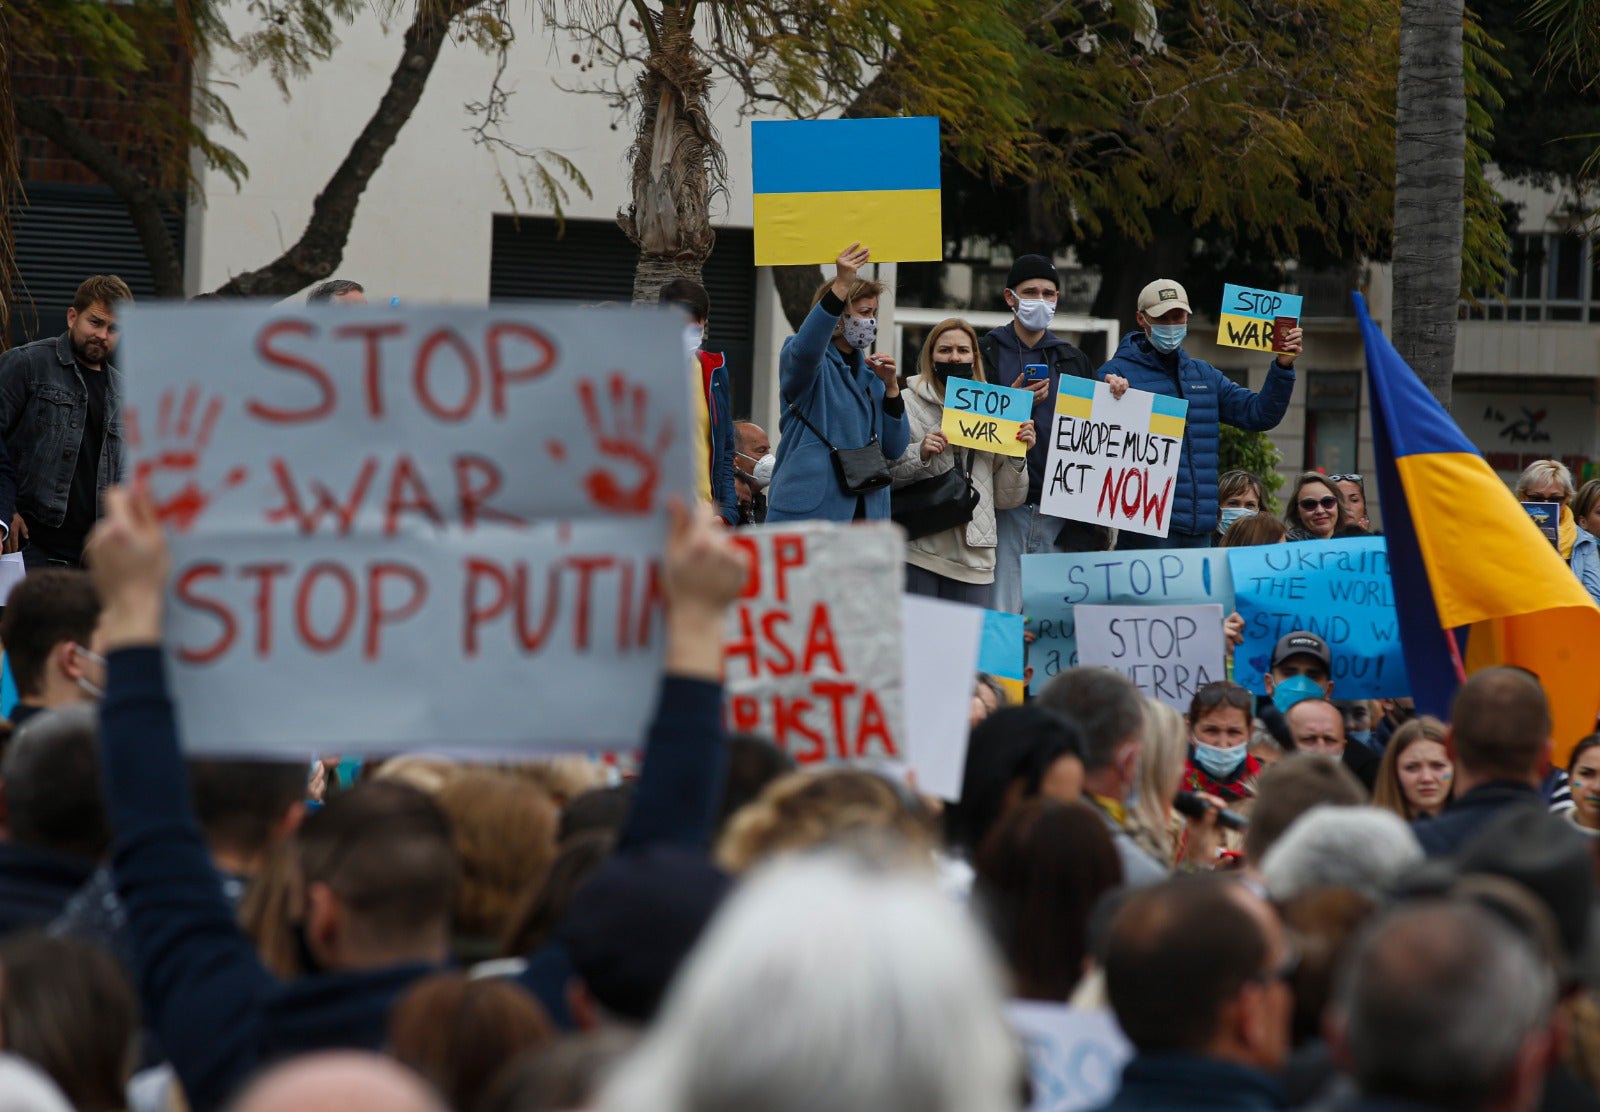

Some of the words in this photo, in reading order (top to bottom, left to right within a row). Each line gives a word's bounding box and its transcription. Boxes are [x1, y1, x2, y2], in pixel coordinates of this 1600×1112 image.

[1234, 292, 1282, 315] STOP
[1227, 321, 1275, 347] WAR
[245, 318, 560, 423] STOP
[954, 388, 1011, 415] STOP
[959, 420, 1002, 444] WAR
[1056, 416, 1122, 457] EUROPE
[1122, 431, 1178, 466] MUST
[266, 454, 527, 537] WAR
[1050, 459, 1095, 496] ACT
[1096, 466, 1174, 530] NOW
[1266, 548, 1390, 574] Ukrain
[1250, 577, 1307, 599] THE
[1329, 580, 1395, 607] WORL
[173, 560, 430, 664] STOP
[1251, 611, 1349, 644] STAND
[1110, 616, 1197, 659] STOP
[1120, 664, 1212, 699] ERRA
[1334, 654, 1385, 691] OU!
